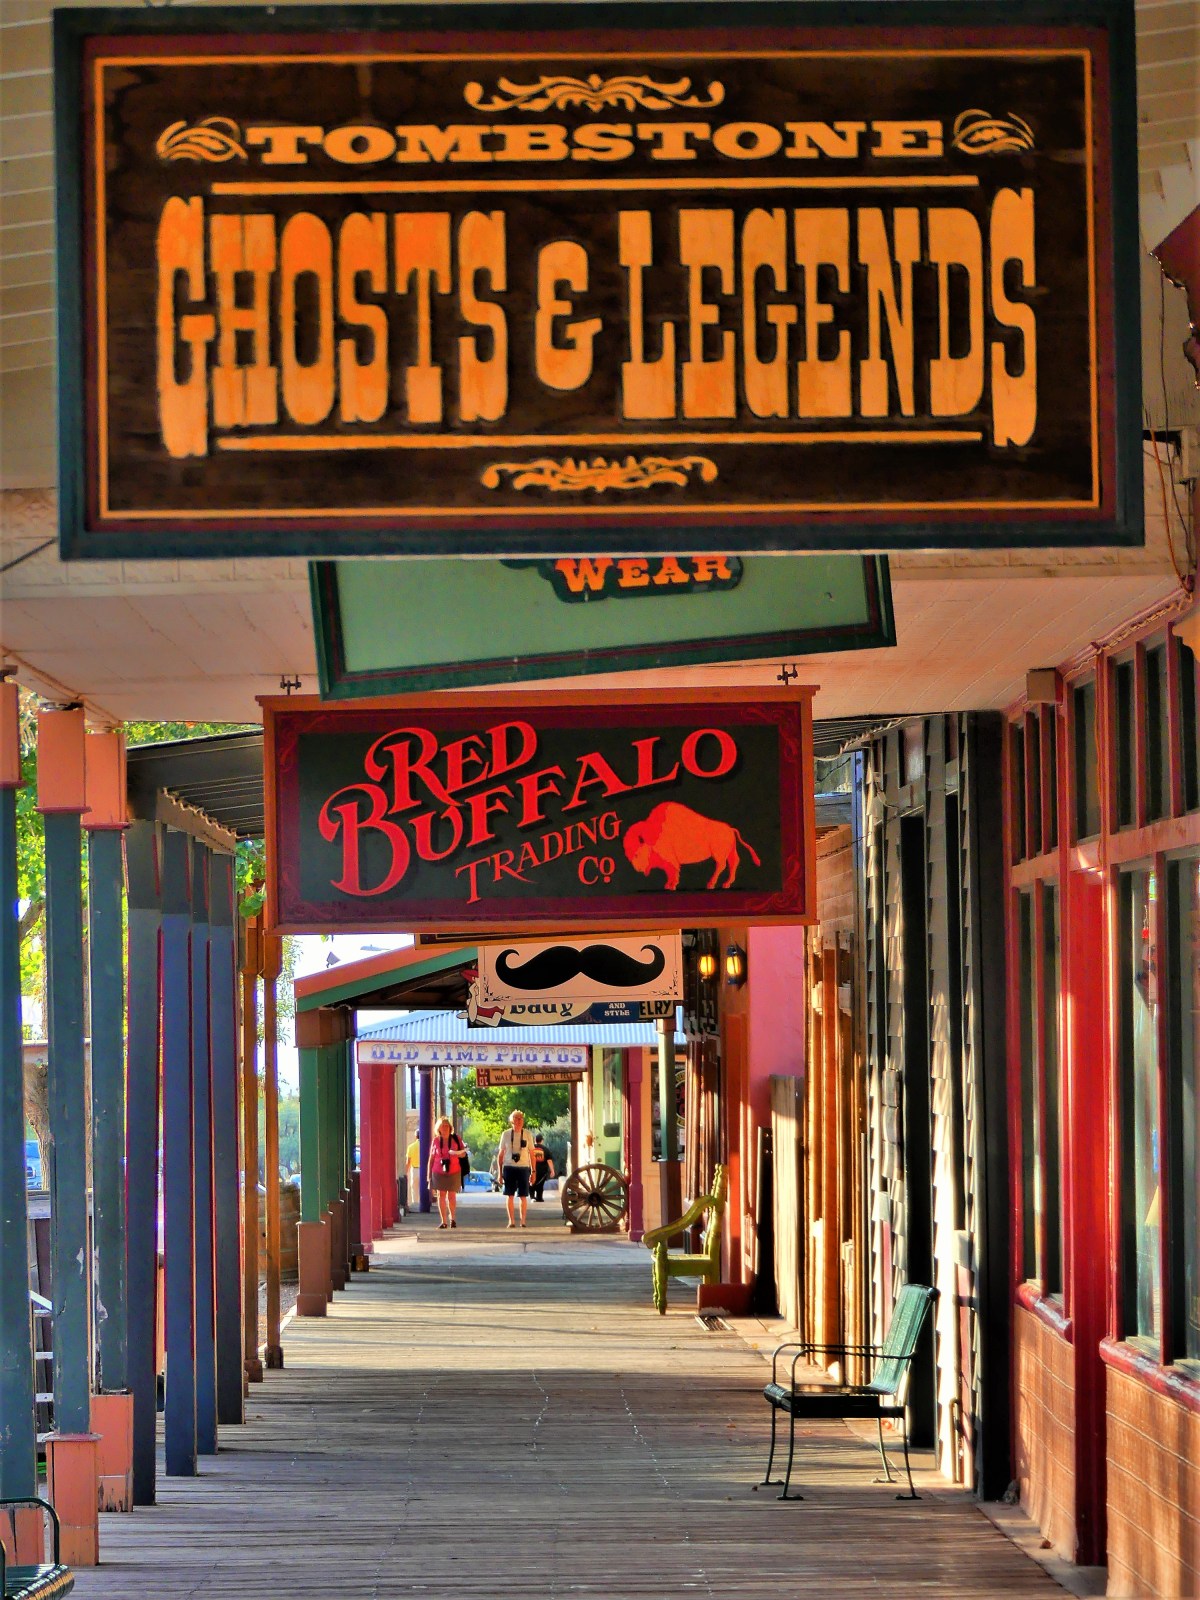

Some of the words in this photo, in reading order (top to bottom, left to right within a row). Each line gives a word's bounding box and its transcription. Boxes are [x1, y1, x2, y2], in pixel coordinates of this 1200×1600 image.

[246, 119, 944, 167] TOMBSTONE
[156, 194, 509, 459] GHOSTS
[535, 240, 601, 391] &
[618, 187, 1038, 447] LEGENDS
[555, 555, 733, 592] WEAR
[364, 720, 538, 816] RED
[318, 727, 738, 898] BUFFALO
[454, 811, 623, 905] TRADING
[604, 1009, 630, 1017] STYLE
[371, 1043, 420, 1061] OLD
[426, 1044, 489, 1062] TIME
[494, 1045, 583, 1064] PHOTOS
